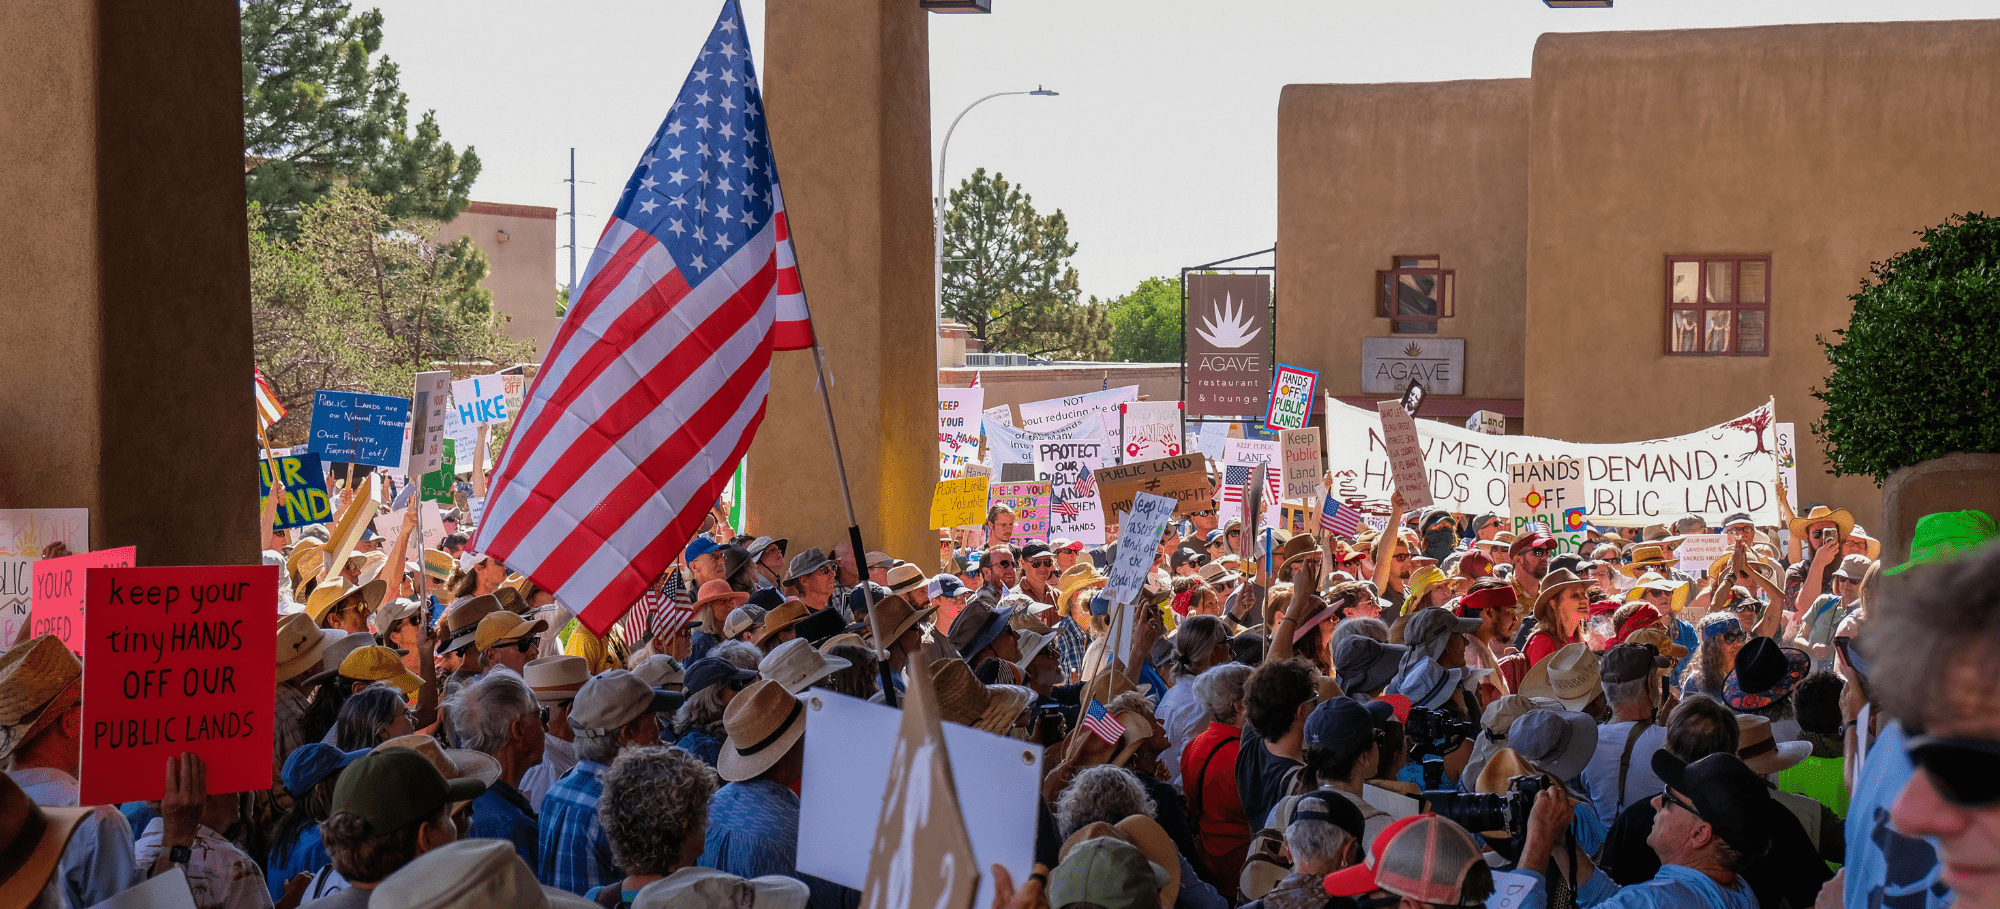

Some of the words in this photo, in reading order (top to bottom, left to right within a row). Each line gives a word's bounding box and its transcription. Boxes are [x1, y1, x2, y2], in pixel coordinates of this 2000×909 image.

[1199, 356, 1260, 372] AGAVE
[1375, 362, 1450, 381] AGAVE
[474, 379, 481, 397] I
[504, 381, 522, 394] OFF
[1198, 379, 1258, 387] restaurant
[1282, 372, 1308, 387] HANDS
[1063, 396, 1085, 407] NOT
[1198, 394, 1205, 402] &
[1213, 393, 1258, 404] lounge
[1274, 397, 1306, 416] PUBLIC
[458, 394, 507, 425] HIKE
[940, 417, 964, 427] YOUR
[1273, 412, 1302, 429] LANDS
[1481, 411, 1505, 428] Land
[1126, 423, 1174, 443] HANDS
[1288, 432, 1314, 445] Keep
[1039, 444, 1101, 462] PROTECT
[1286, 447, 1318, 462] Public
[259, 457, 307, 488] UR
[1055, 461, 1079, 472] OUR
[1100, 464, 1147, 482] PUBLIC
[1153, 457, 1192, 473] LAND
[1290, 465, 1316, 480] Land
[1513, 460, 1580, 484] HANDS
[992, 485, 1020, 496] KEEP
[1685, 480, 1768, 514] LAND
[1023, 521, 1046, 532] OUR
[1061, 513, 1077, 524] IN
[1068, 522, 1096, 532] HANDS
[0, 561, 28, 596] LIC
[37, 569, 73, 601] YOUR
[109, 577, 180, 614] keep
[190, 581, 250, 614] your
[13, 604, 26, 615] IN
[106, 626, 164, 663] tiny
[171, 619, 243, 652] HANDS
[123, 668, 172, 699] OFF
[183, 666, 236, 697] OUR
[94, 717, 176, 750] PUBLIC
[185, 711, 254, 742] LANDS
